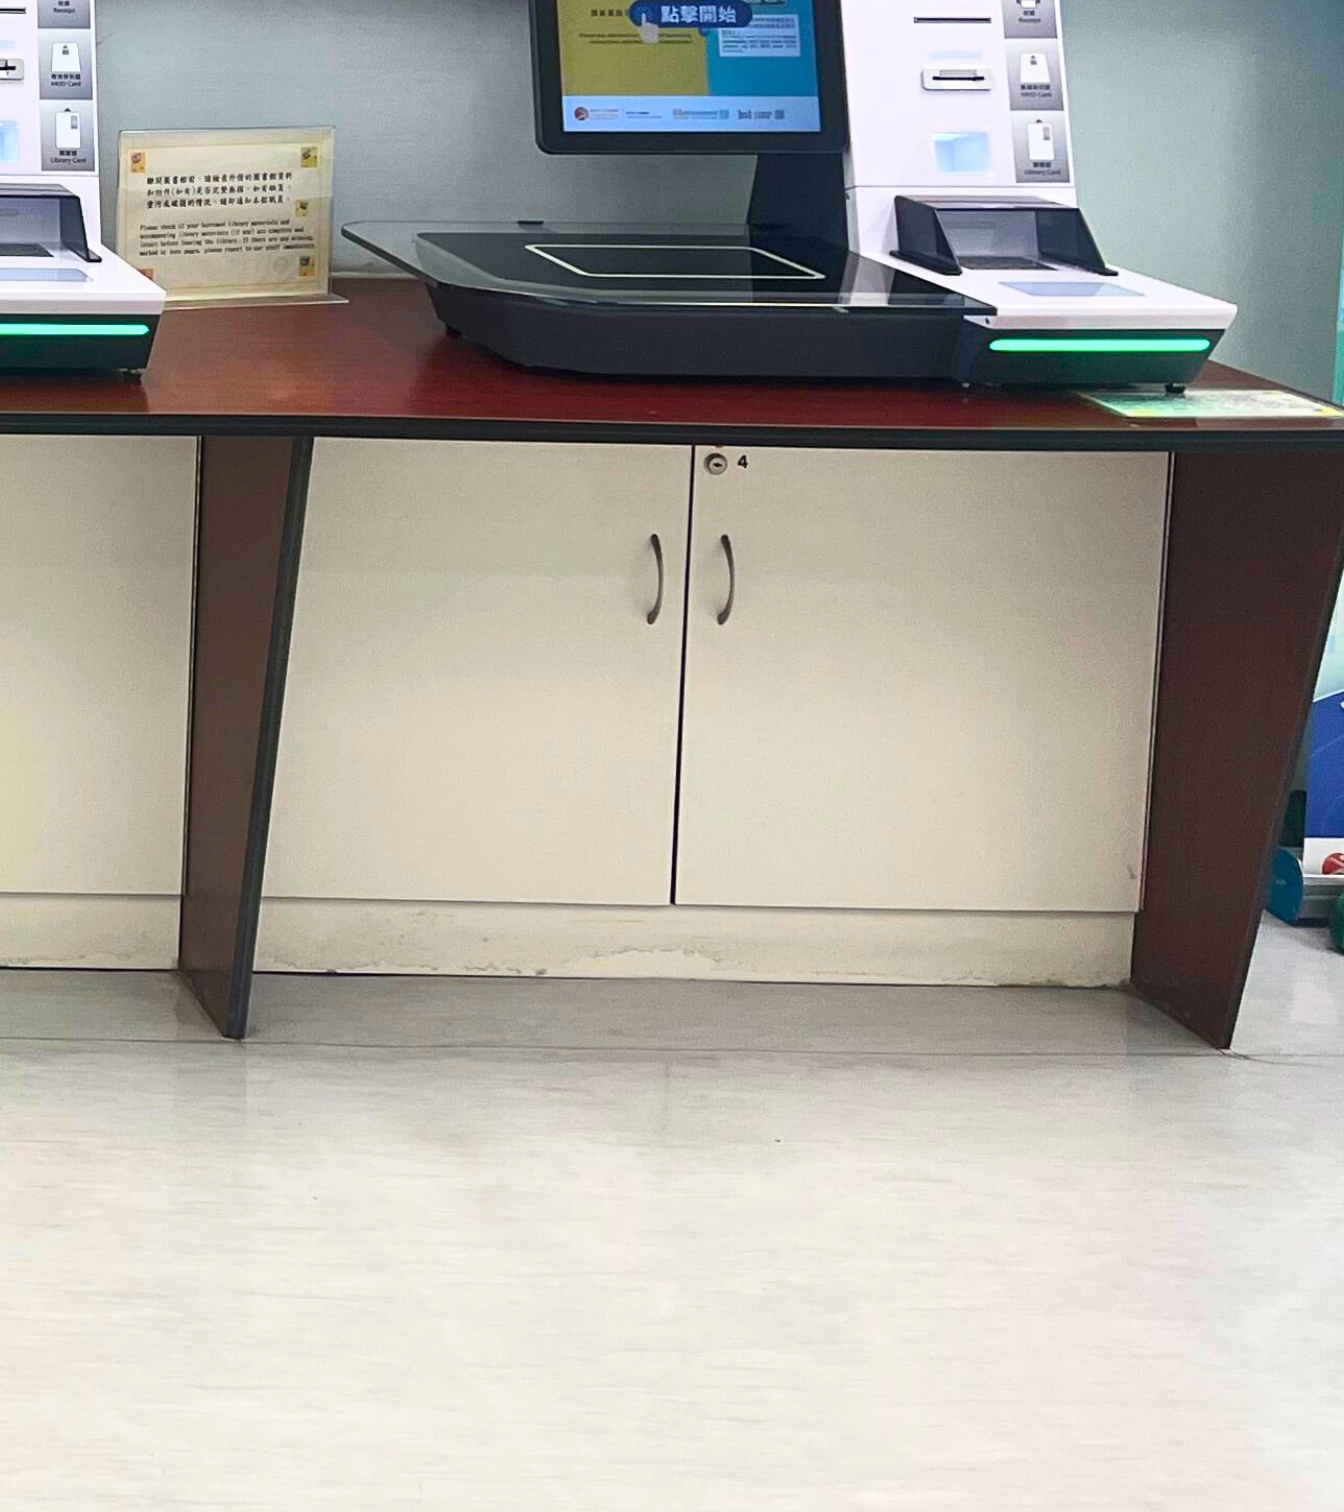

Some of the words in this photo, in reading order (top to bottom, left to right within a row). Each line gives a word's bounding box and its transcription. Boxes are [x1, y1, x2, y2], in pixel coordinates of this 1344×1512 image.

[661, 5, 736, 23] 點擊開始
[737, 454, 748, 469] 4
